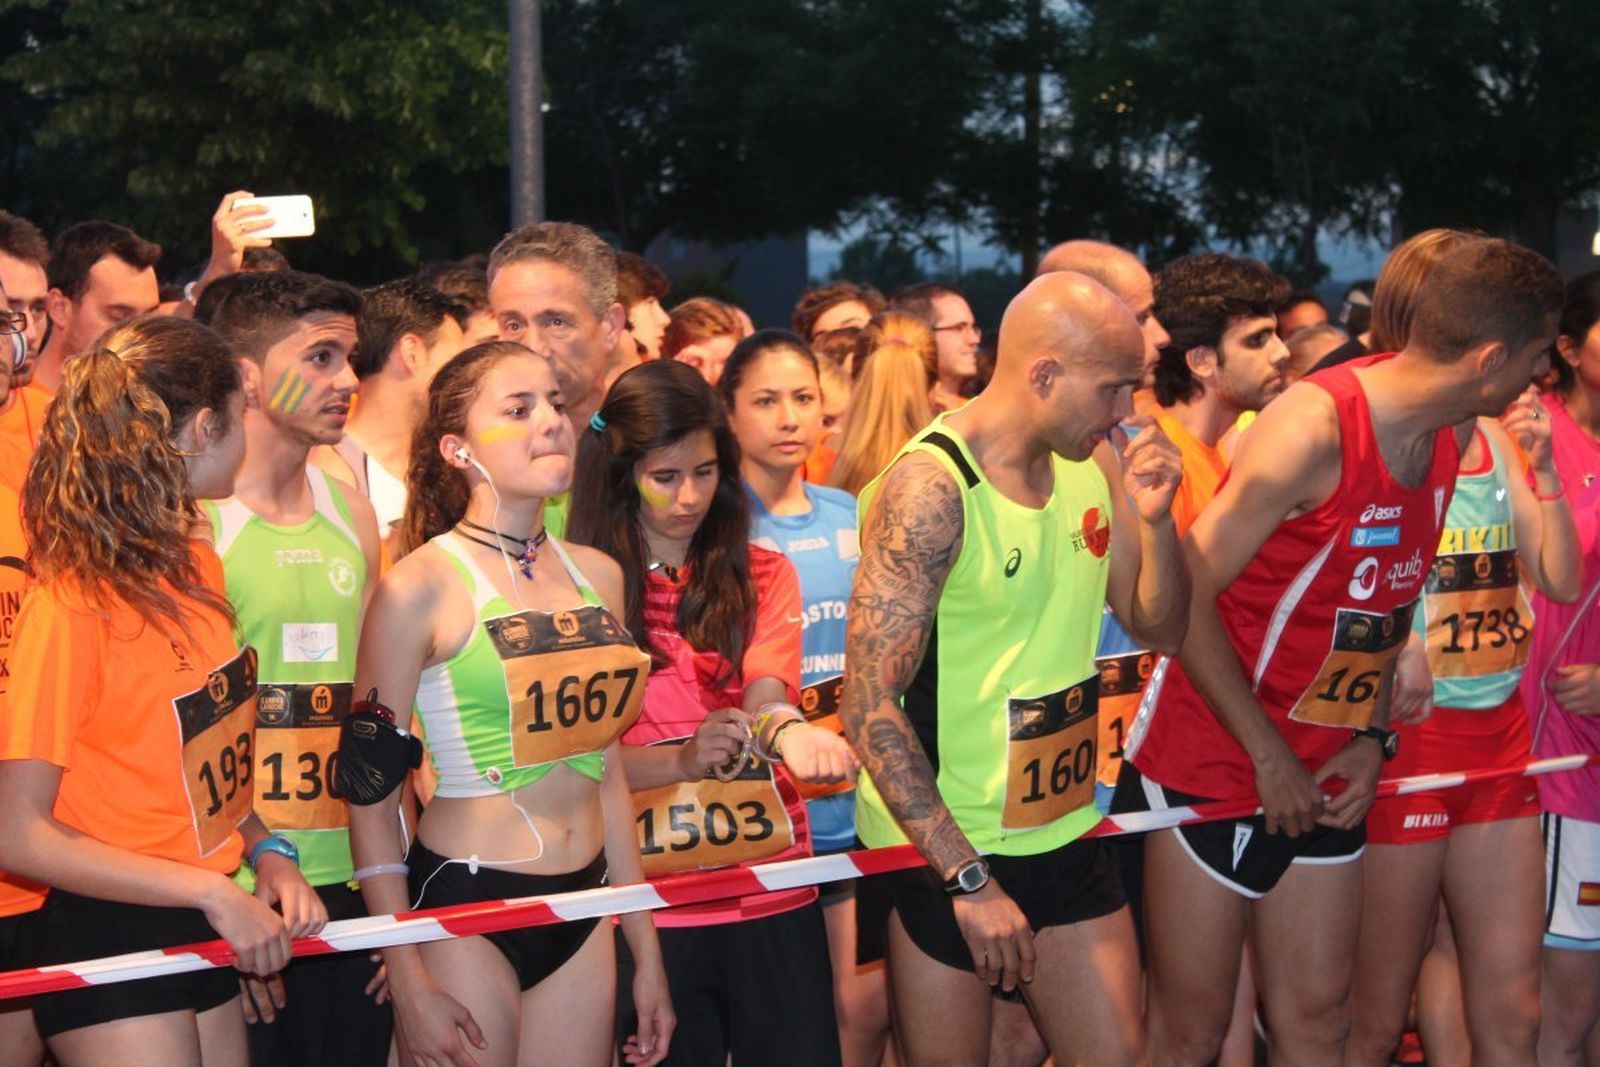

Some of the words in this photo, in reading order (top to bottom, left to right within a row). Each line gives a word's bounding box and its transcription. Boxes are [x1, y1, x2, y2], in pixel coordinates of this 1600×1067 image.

[1441, 606, 1529, 654] 1738
[526, 667, 639, 733] 1667
[1316, 666, 1380, 704] 16
[198, 731, 252, 817] 193
[1020, 738, 1098, 804] 160
[636, 800, 774, 856] 1503
